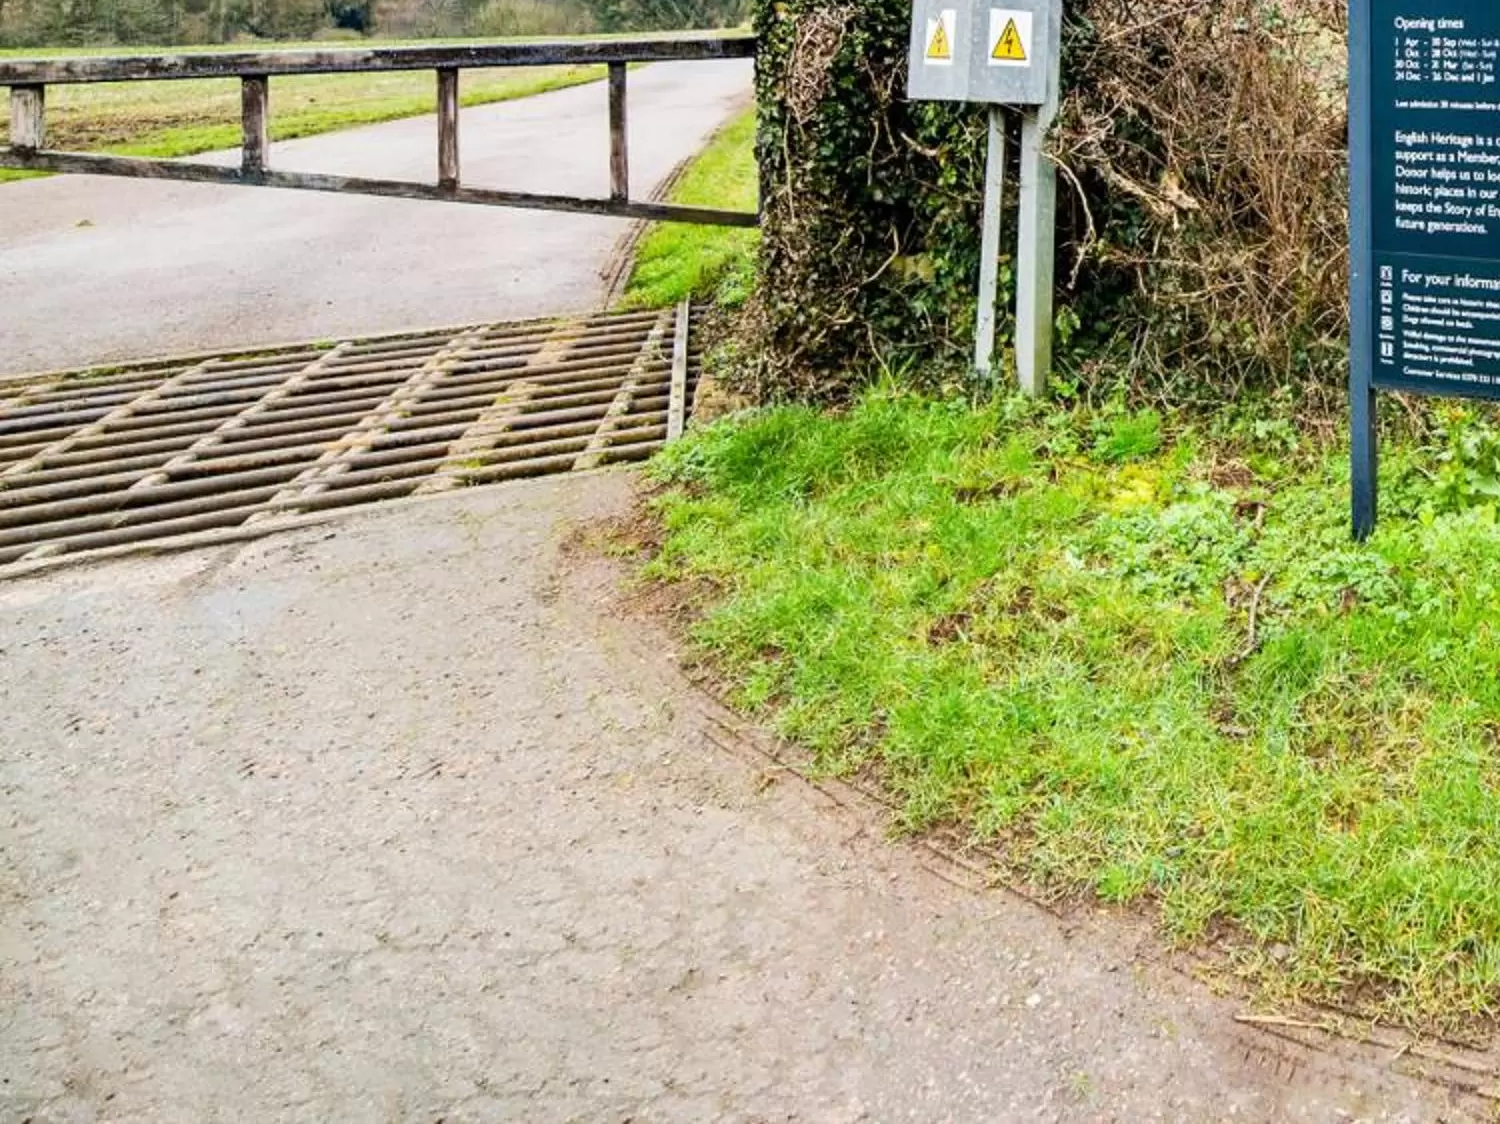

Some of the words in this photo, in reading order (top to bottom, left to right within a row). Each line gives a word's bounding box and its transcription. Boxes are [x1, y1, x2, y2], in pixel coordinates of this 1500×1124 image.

[1394, 16, 1435, 32] Opening
[1437, 18, 1465, 30] times
[1395, 130, 1428, 146] English
[1431, 132, 1473, 148] Heritage
[1475, 133, 1484, 145] is
[1486, 137, 1493, 146] a
[1395, 151, 1434, 163] support
[1436, 153, 1447, 163] as
[1449, 154, 1455, 163] a
[1457, 151, 1500, 165] Member,
[1395, 165, 1428, 178] Donor
[1431, 167, 1457, 181] helps
[1459, 171, 1471, 181] us
[1473, 171, 1485, 182] to
[1395, 182, 1432, 195] historic
[1433, 184, 1464, 199] places
[1467, 186, 1476, 198] in
[1479, 189, 1497, 199] our
[1395, 199, 1423, 213] keeps
[1425, 201, 1442, 214] the
[1444, 201, 1471, 218] Story
[1475, 203, 1486, 217] of
[1395, 216, 1425, 230] future
[1427, 220, 1488, 234] generations.
[1402, 269, 1422, 283] For
[1424, 273, 1452, 288] your
